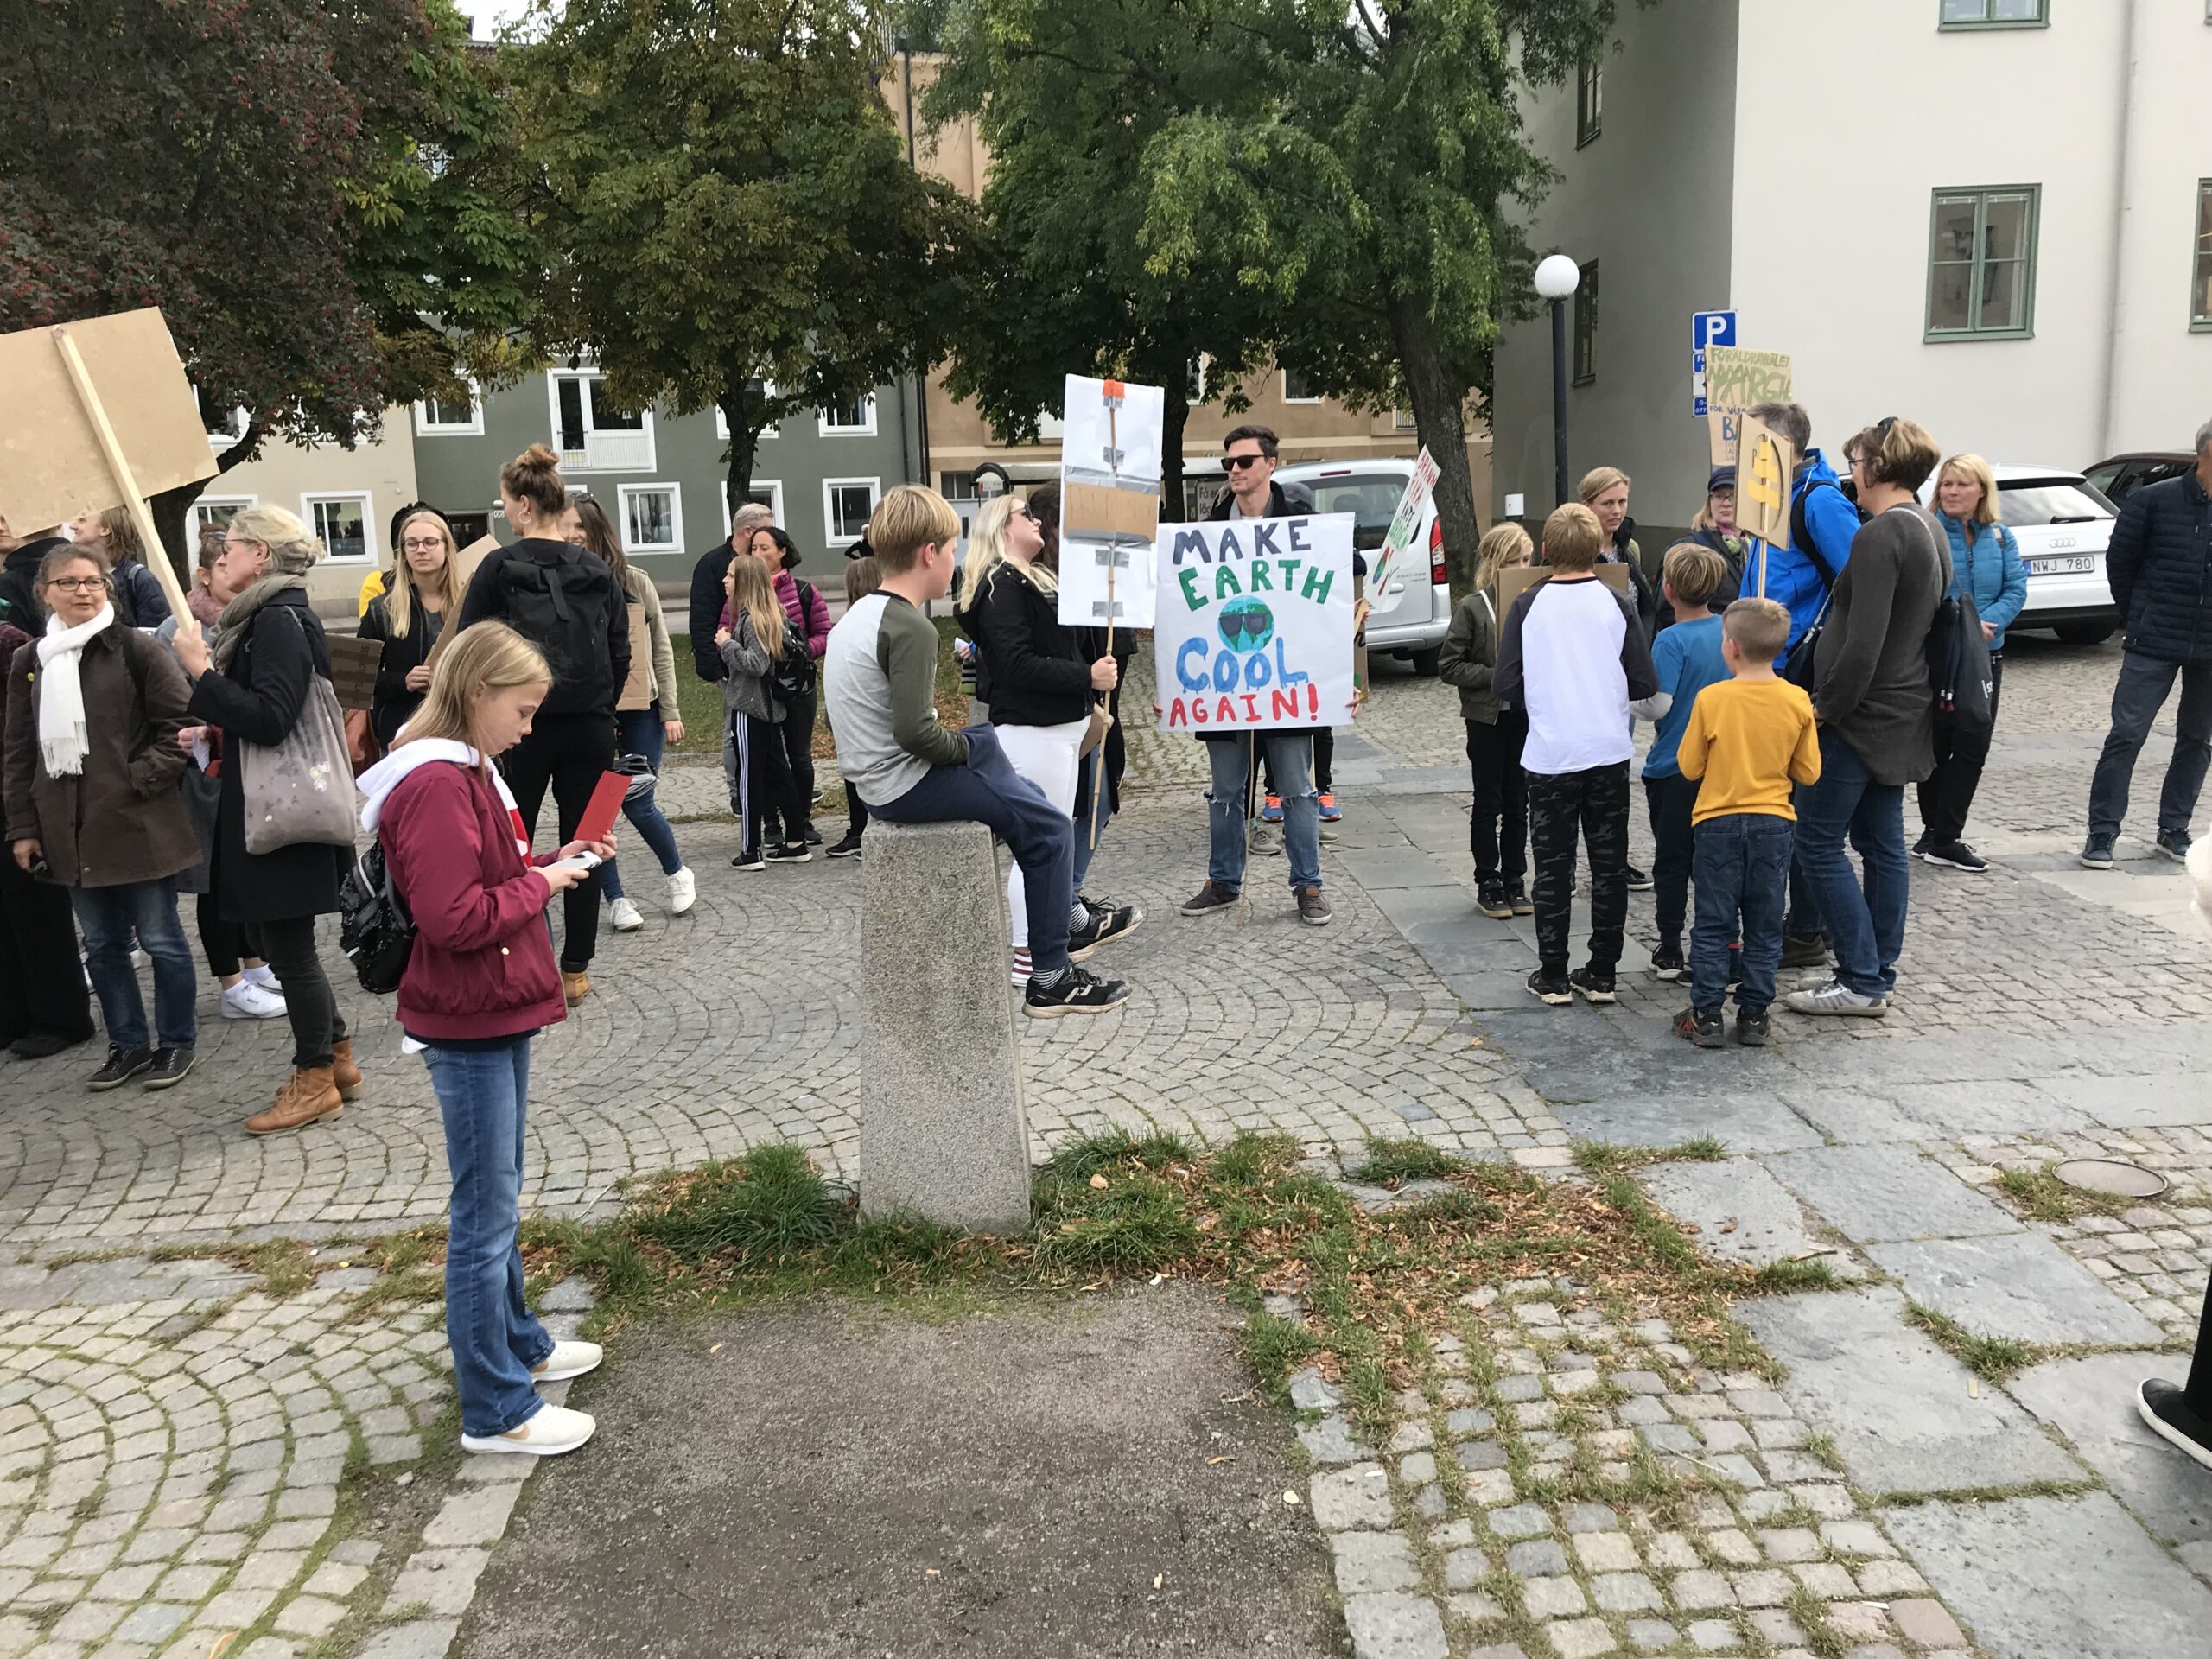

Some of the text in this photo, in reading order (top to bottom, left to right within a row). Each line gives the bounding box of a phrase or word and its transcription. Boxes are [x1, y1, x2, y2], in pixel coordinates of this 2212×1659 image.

[1706, 315, 1726, 346] P
[1173, 518, 1311, 565] MAKE
[1178, 559, 1335, 612] EARTH
[2032, 557, 2091, 573] NWJ 780
[1176, 636, 1309, 694] COOL
[1169, 683, 1319, 728] AGAIN!
